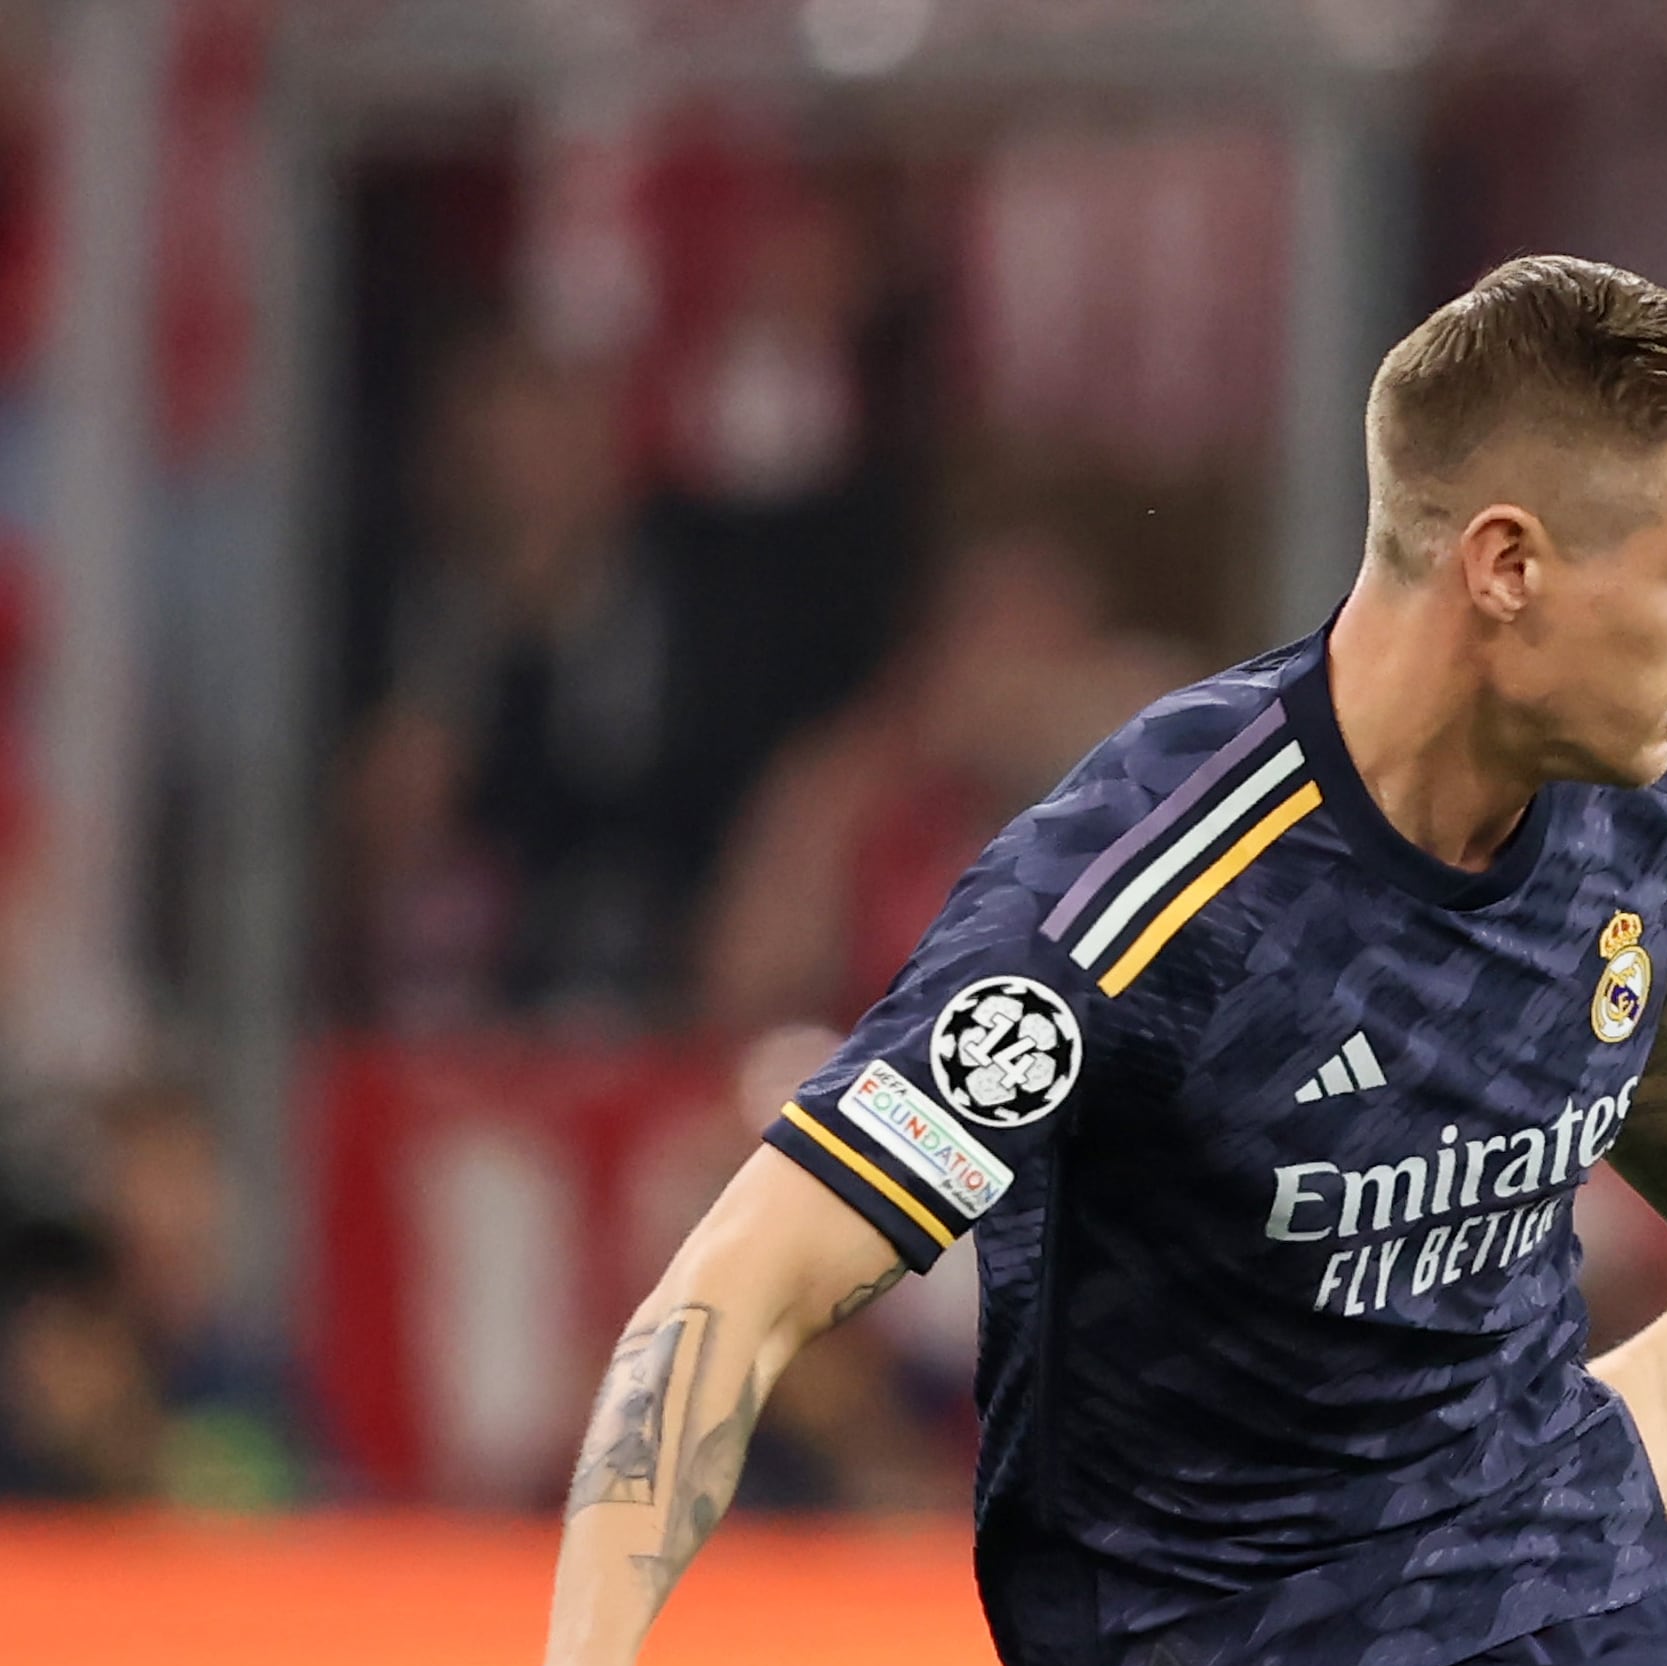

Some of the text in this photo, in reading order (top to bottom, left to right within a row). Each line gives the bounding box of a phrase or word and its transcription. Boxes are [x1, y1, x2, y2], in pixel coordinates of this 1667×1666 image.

[872, 1066, 908, 1098] UEFA
[962, 1011, 1038, 1092] 14
[858, 1079, 999, 1203] FOUNDATION
[1313, 1236, 1407, 1318] FLY
